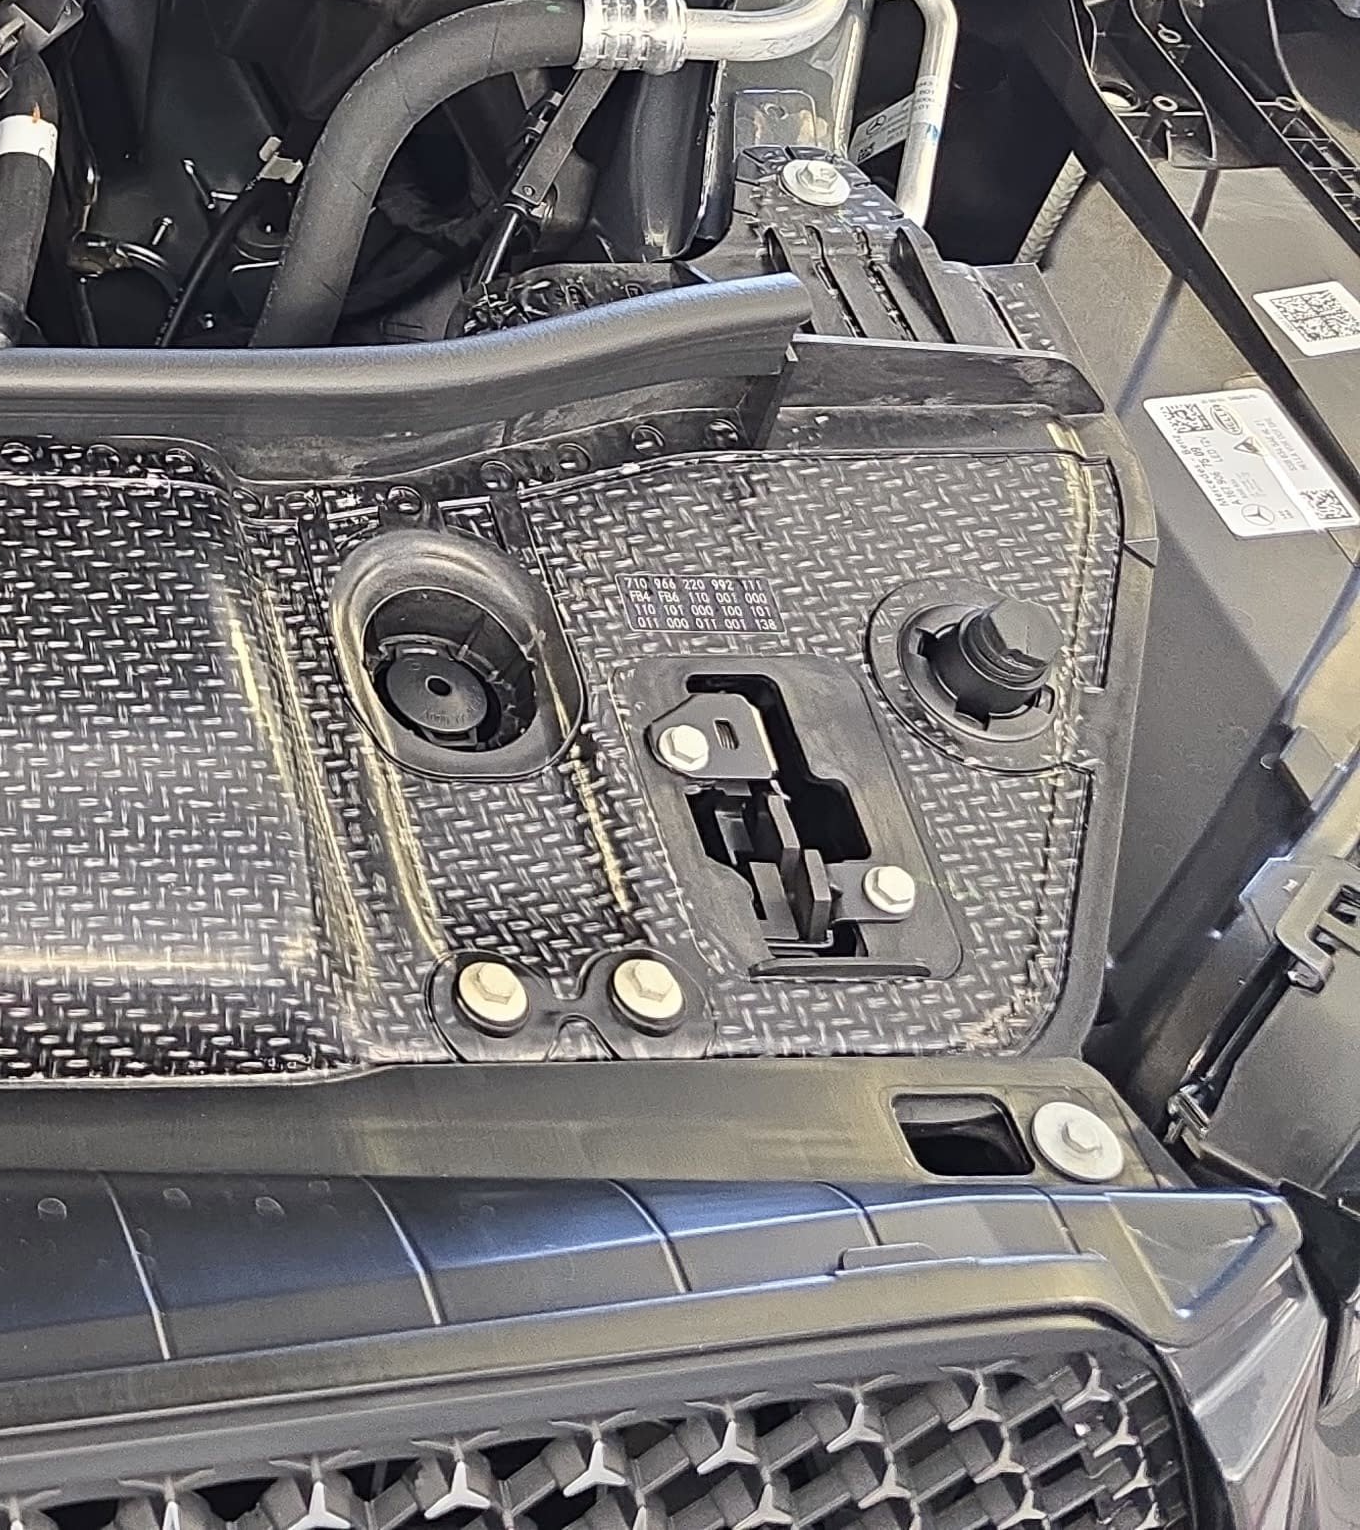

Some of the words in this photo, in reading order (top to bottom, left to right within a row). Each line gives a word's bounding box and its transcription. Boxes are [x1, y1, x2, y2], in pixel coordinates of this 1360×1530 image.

[624, 577, 648, 590] 710
[654, 578, 676, 590] 966
[684, 578, 705, 590] 220
[711, 579, 734, 590] 992
[742, 579, 763, 591] 111
[630, 590, 651, 602] FB4
[659, 591, 680, 602] FB6
[688, 592, 710, 603] 110
[715, 593, 738, 603] 001
[744, 593, 767, 603] 000
[634, 604, 656, 615] 110
[664, 605, 684, 615] 101
[691, 605, 714, 616] 000
[721, 606, 742, 616] 100
[750, 606, 771, 617] 101
[638, 617, 659, 629] 011
[667, 618, 689, 629] 000
[696, 618, 717, 630] 011
[725, 619, 747, 630] 001
[755, 619, 777, 630] 138
